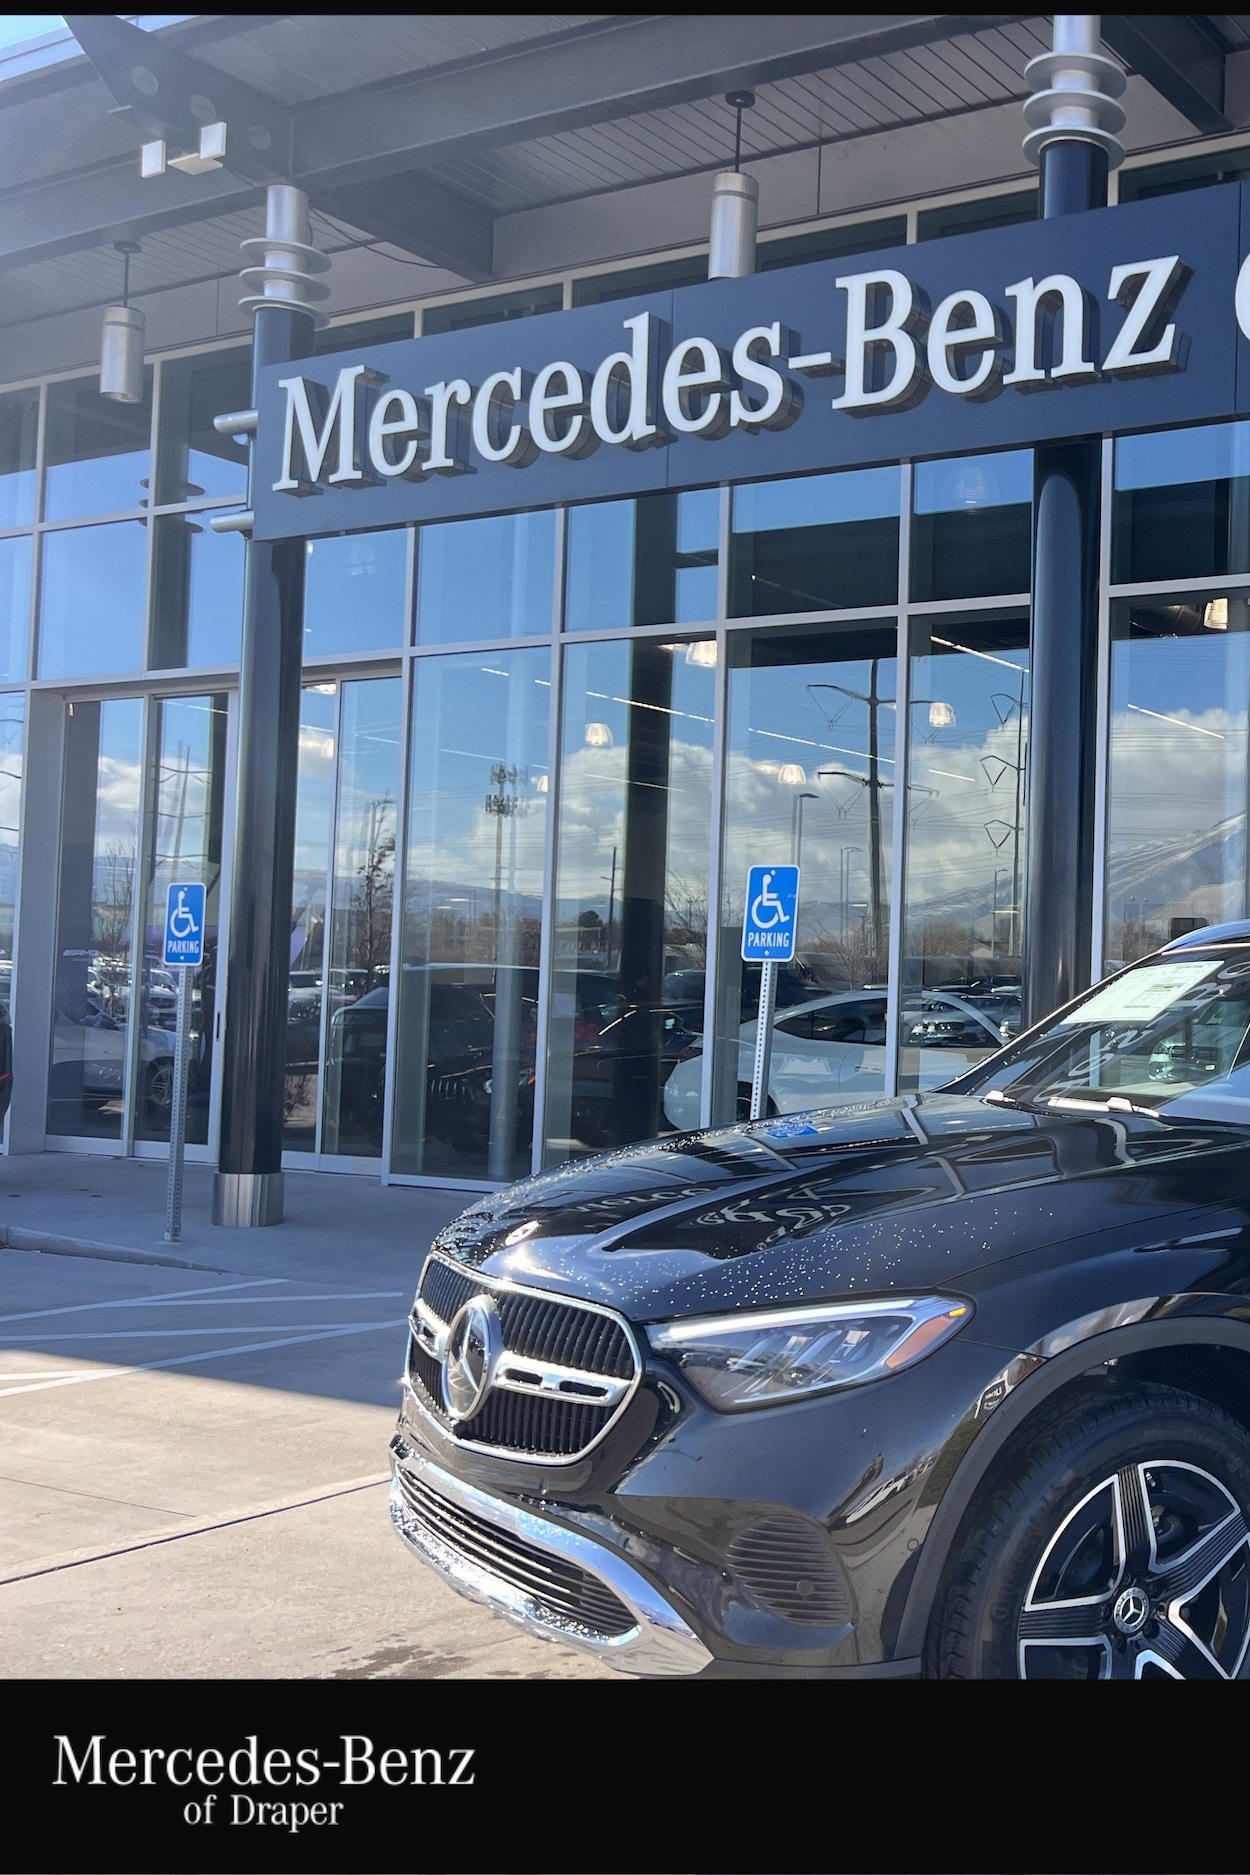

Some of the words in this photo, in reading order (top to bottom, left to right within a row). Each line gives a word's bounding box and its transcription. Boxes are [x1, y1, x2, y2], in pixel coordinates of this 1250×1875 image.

[273, 256, 1180, 491] Mercedes-Benz
[167, 940, 200, 954] PARKING
[747, 932, 790, 948] PARKING
